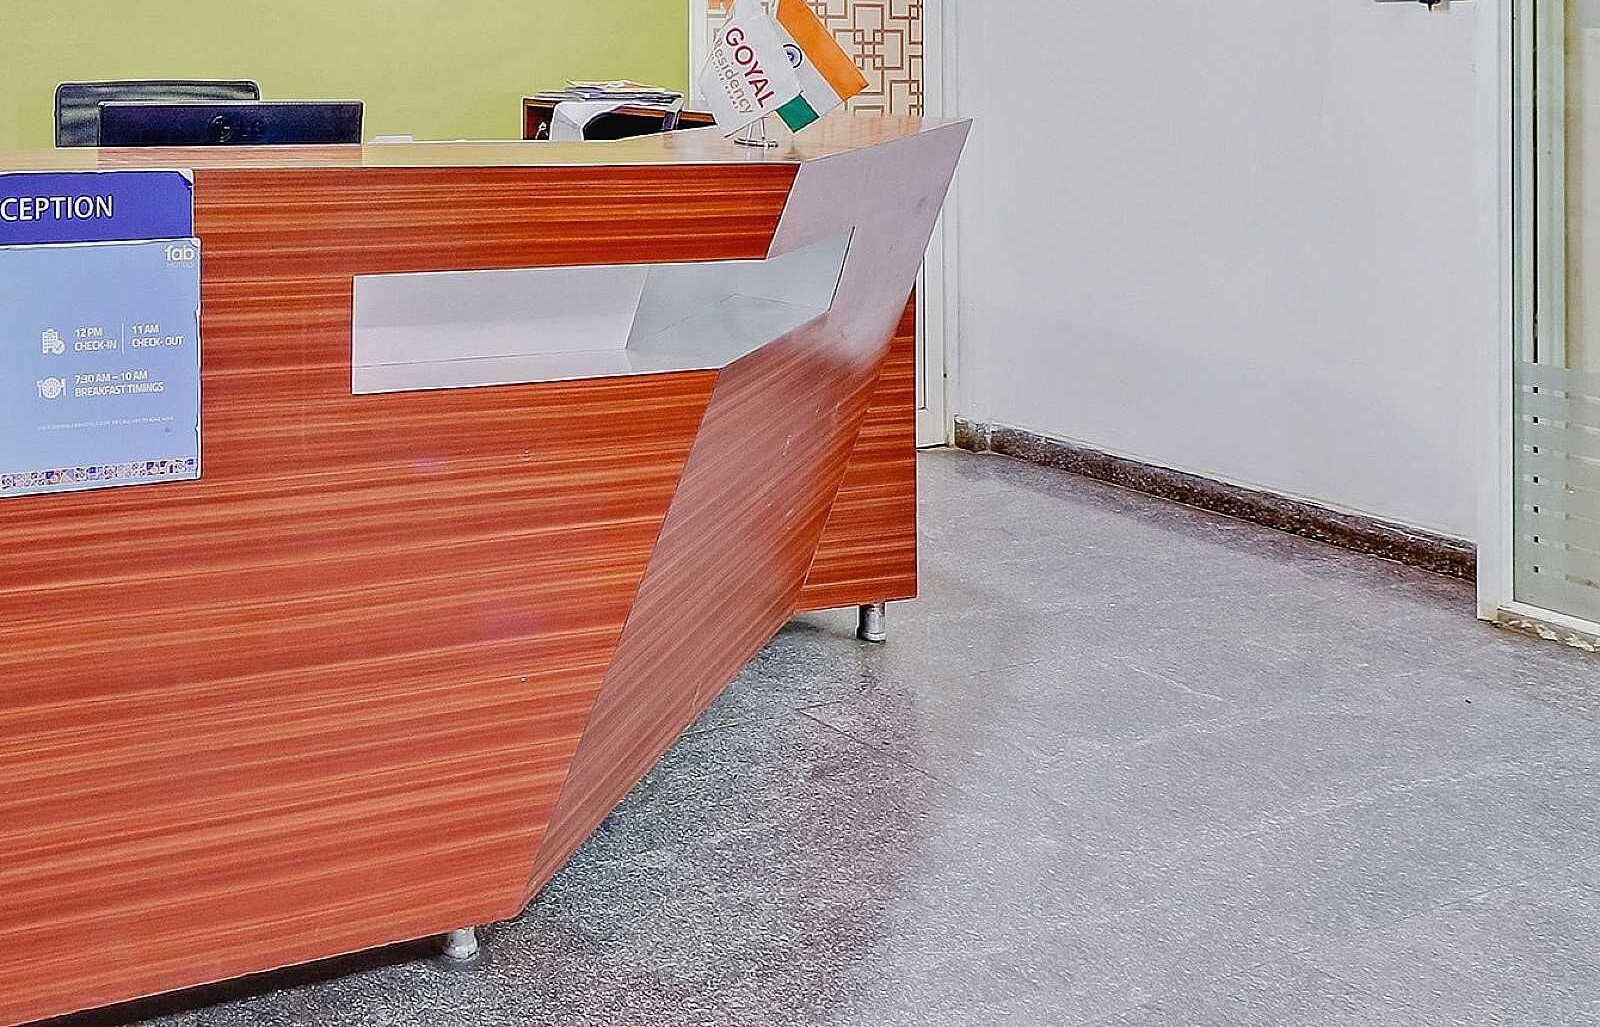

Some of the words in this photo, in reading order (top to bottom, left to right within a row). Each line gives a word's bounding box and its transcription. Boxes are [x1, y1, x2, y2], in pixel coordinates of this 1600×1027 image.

[726, 28, 775, 108] GOYAL
[165, 244, 194, 261] fab
[74, 327, 86, 337] 12
[87, 326, 103, 337] PM
[133, 325, 143, 334] 11
[144, 324, 160, 334] AM
[74, 339, 117, 352] CHECK-IN
[75, 384, 126, 397] BREAKFAST
[128, 382, 164, 394] TIMINGS
